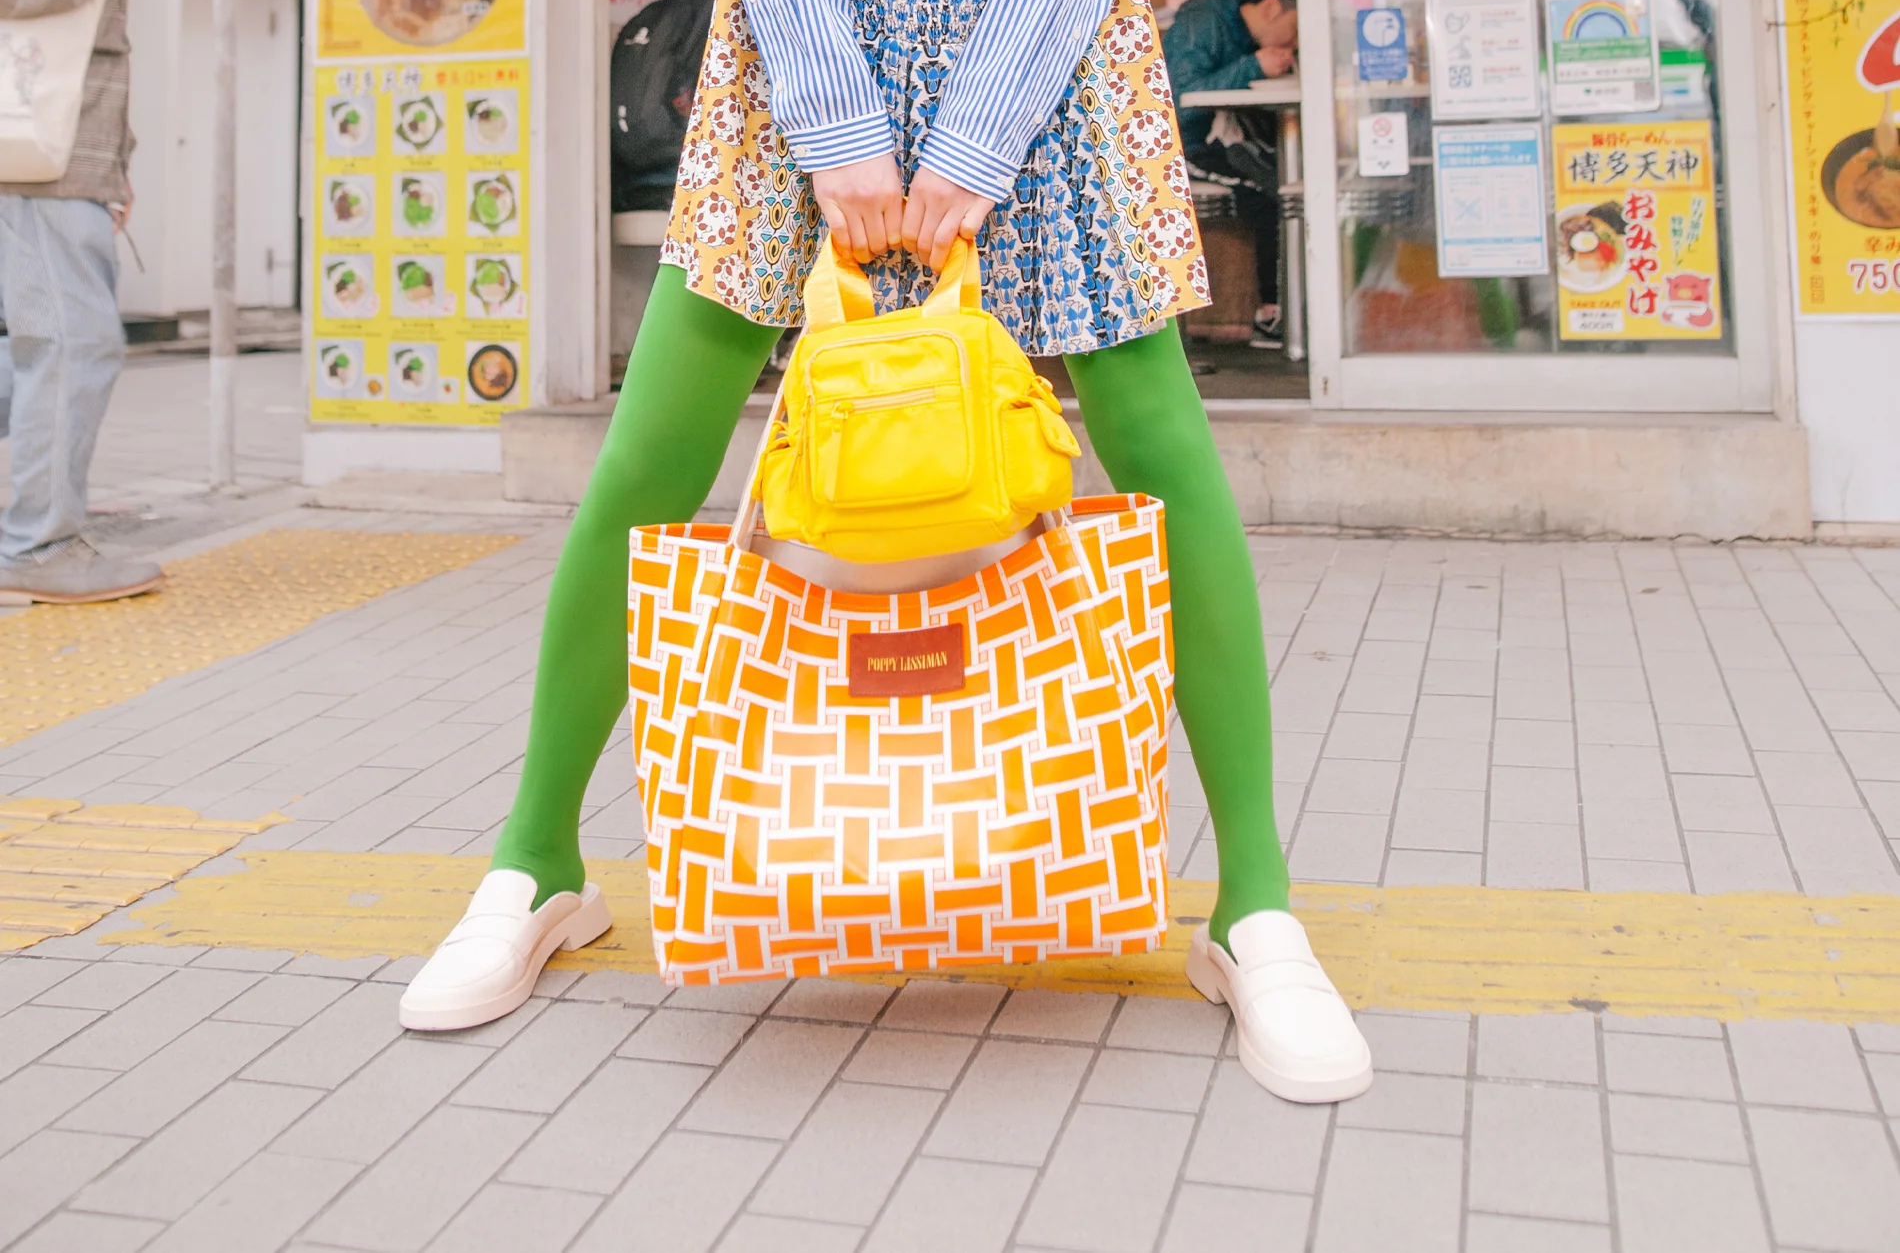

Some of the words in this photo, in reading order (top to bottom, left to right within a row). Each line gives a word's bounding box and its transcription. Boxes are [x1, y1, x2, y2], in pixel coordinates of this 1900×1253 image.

[1568, 149, 1699, 184] 博多天神
[1625, 193, 1659, 315] おみやげ
[867, 657, 898, 672] POPPY
[900, 650, 948, 672] LISSIMAN
